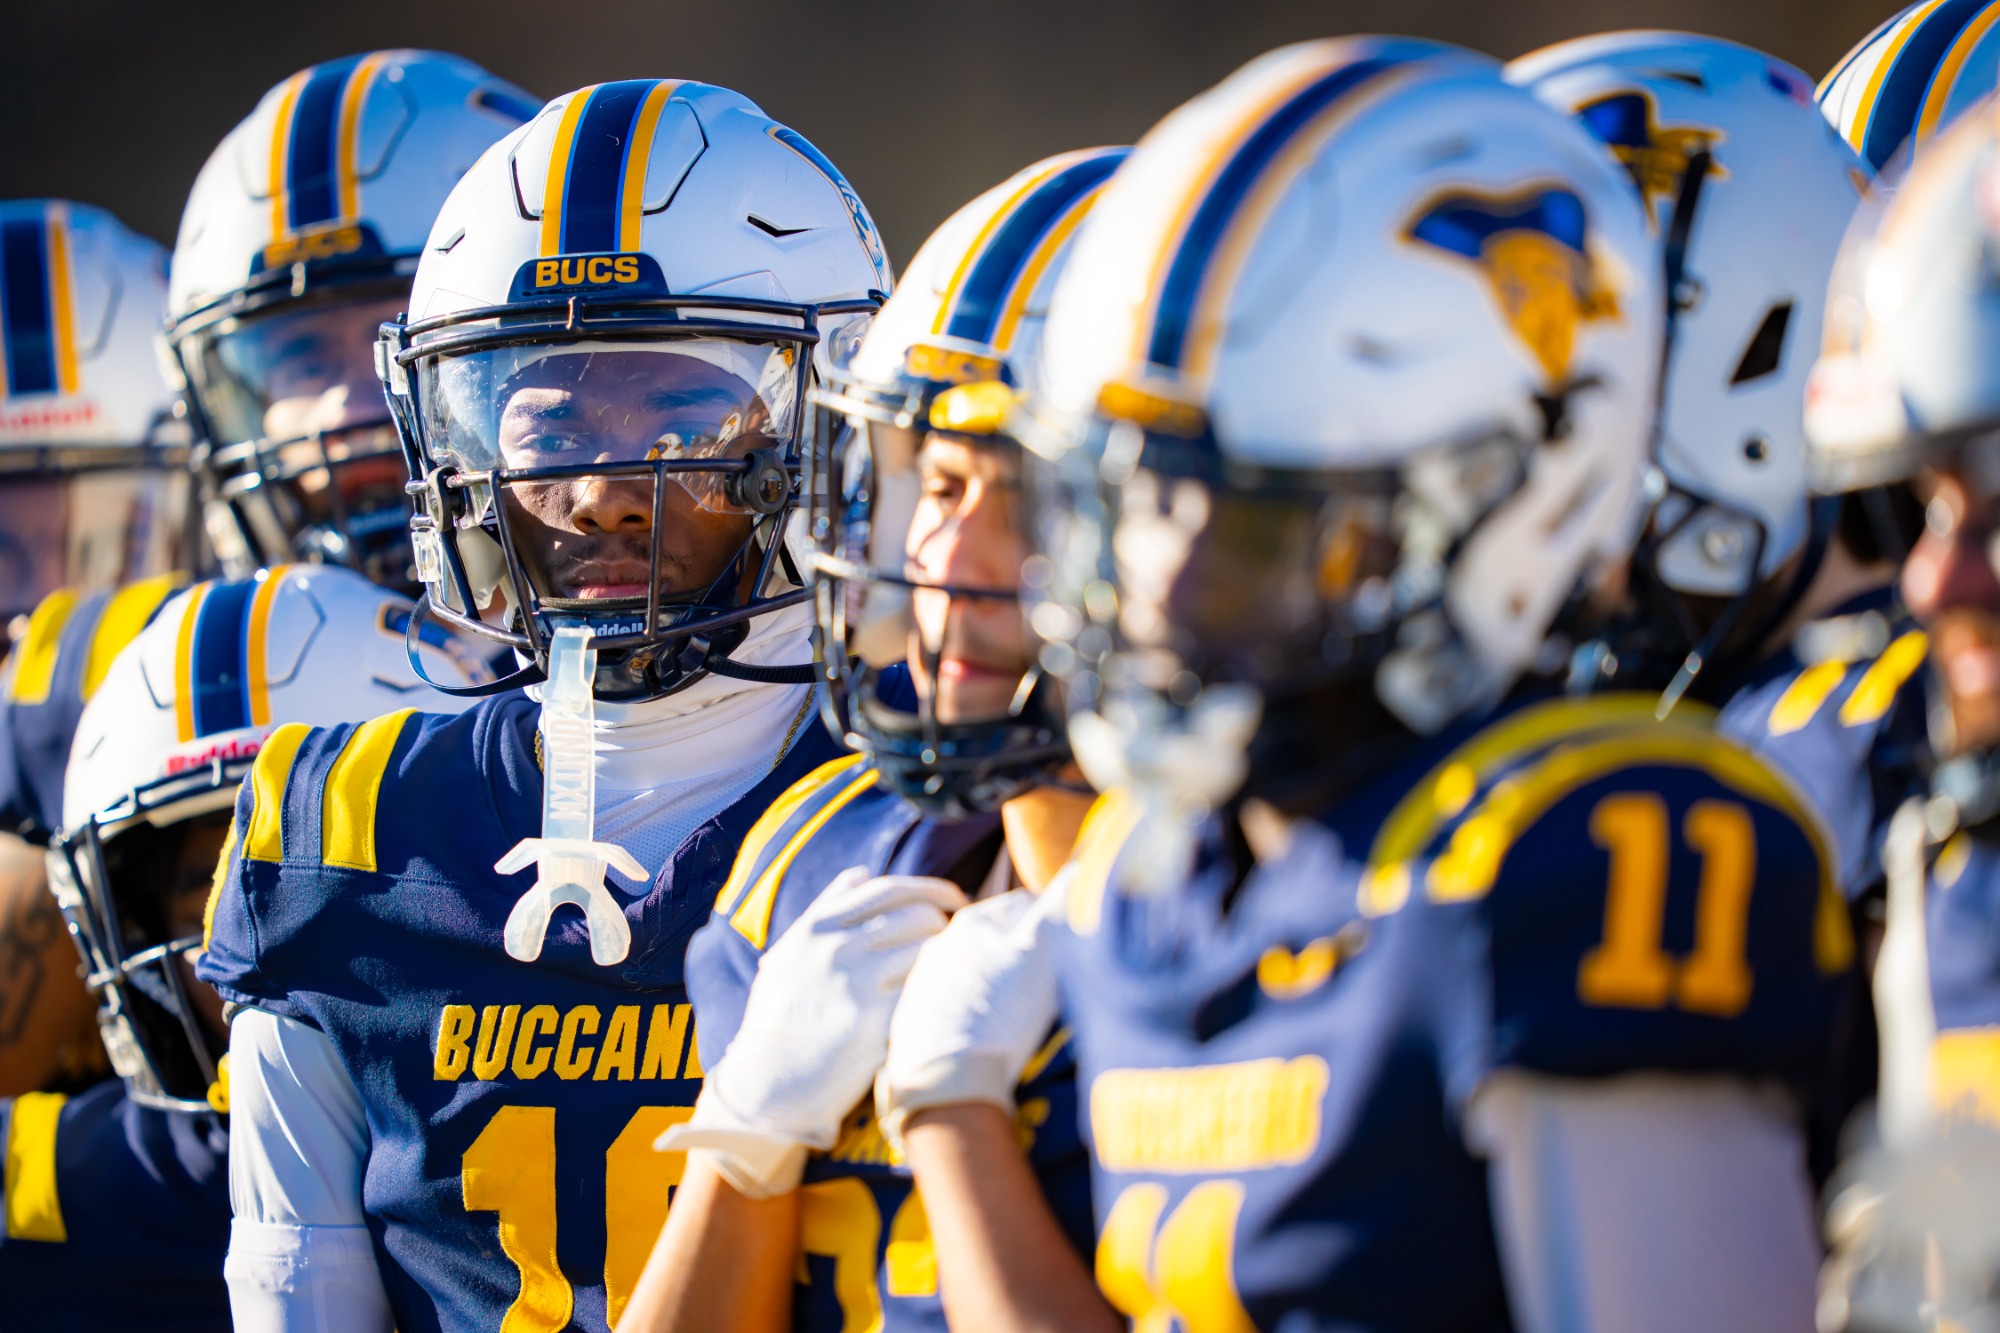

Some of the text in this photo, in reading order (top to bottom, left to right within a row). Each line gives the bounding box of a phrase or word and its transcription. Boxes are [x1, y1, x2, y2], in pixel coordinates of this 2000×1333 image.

[536, 256, 639, 288] BUCS
[580, 623, 643, 637] ddell
[549, 720, 588, 820] MXTRND
[1578, 791, 1756, 1016] 11
